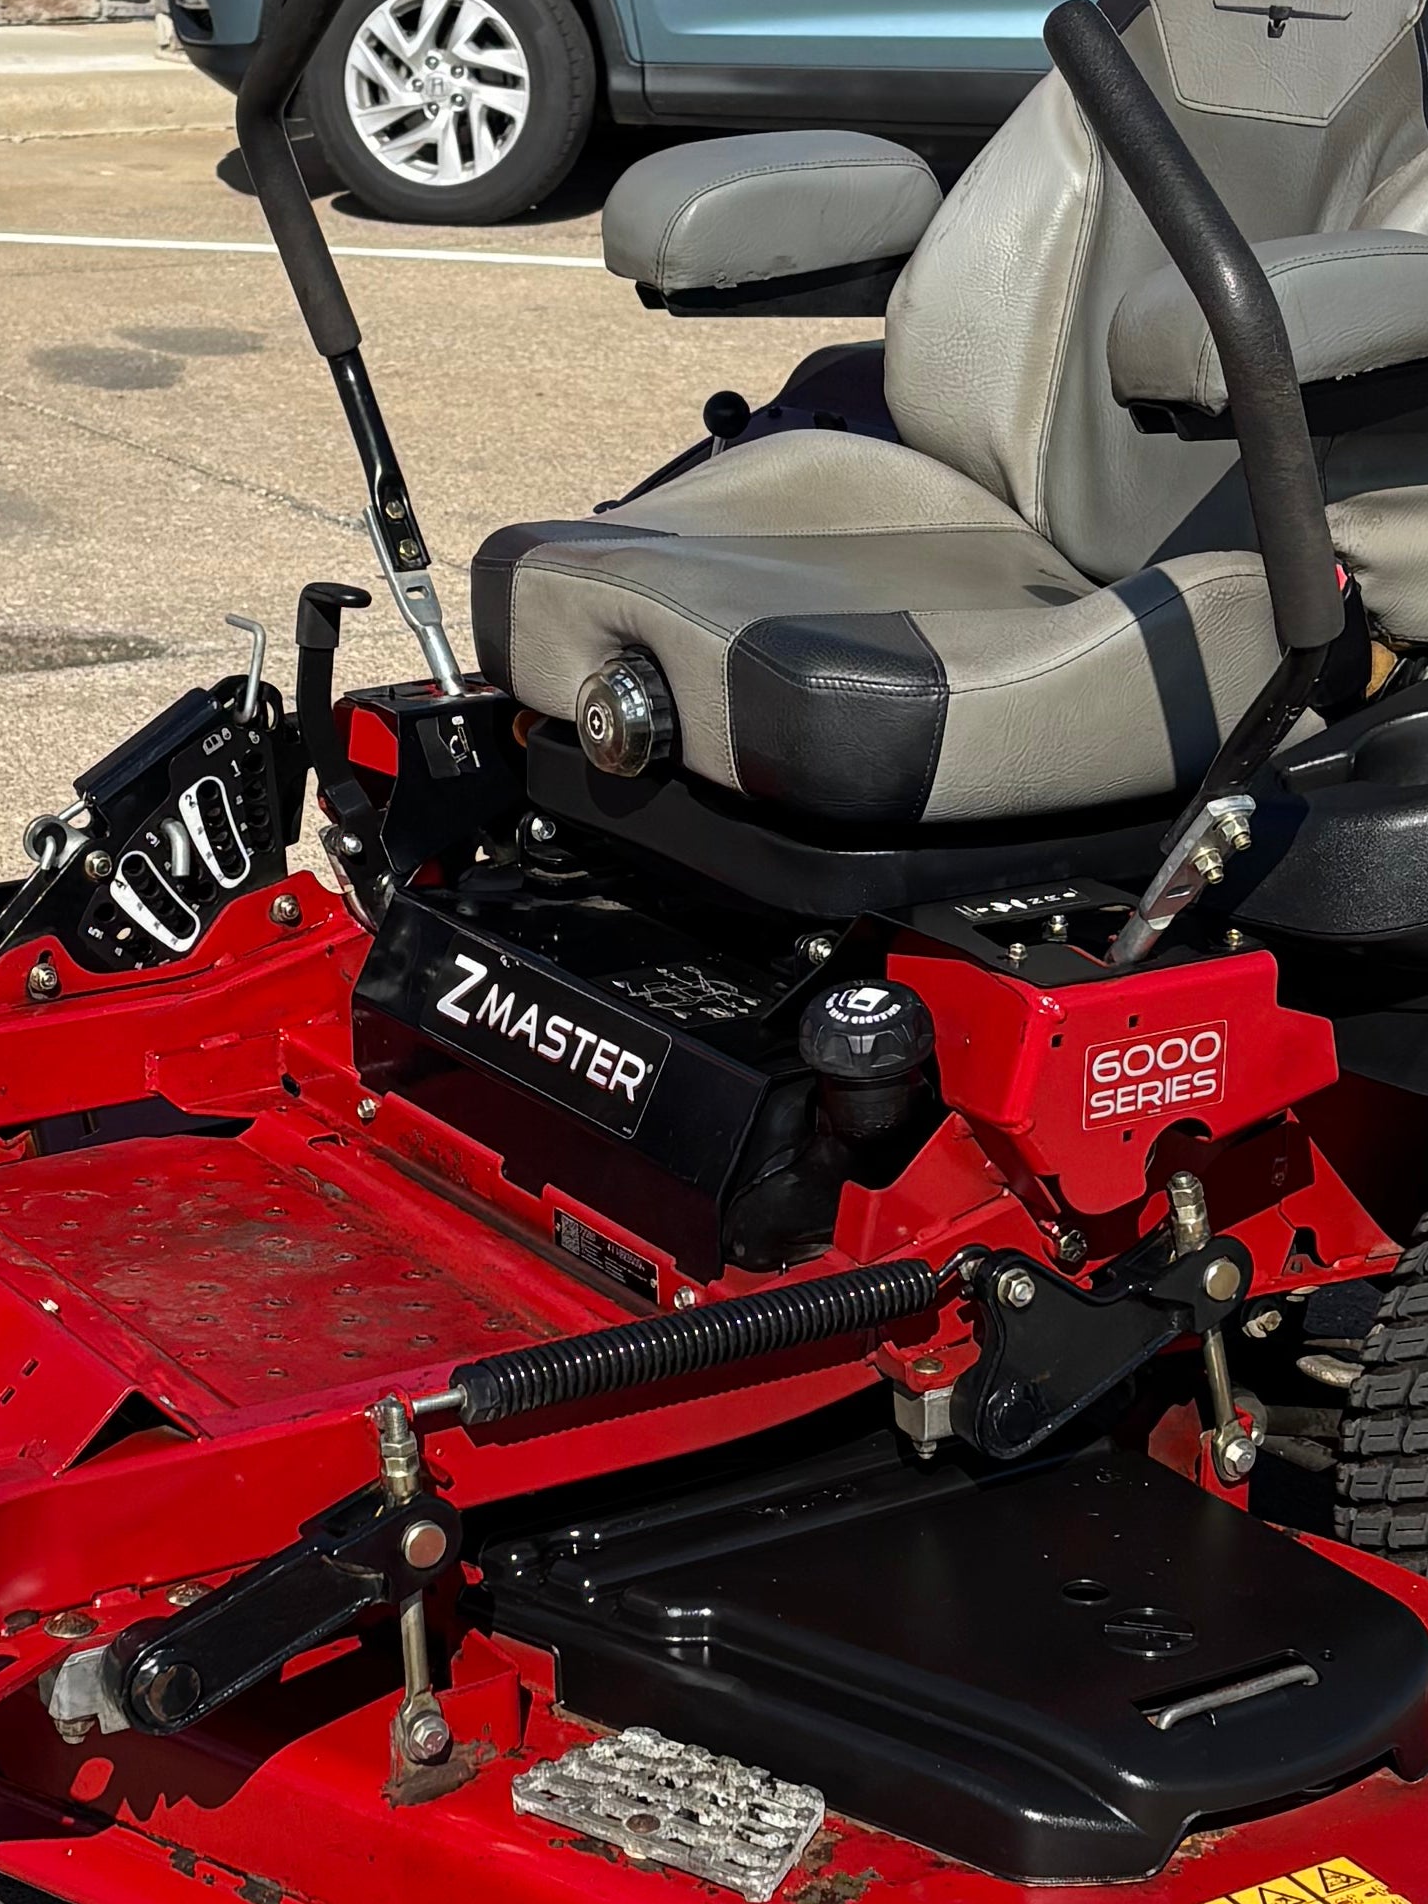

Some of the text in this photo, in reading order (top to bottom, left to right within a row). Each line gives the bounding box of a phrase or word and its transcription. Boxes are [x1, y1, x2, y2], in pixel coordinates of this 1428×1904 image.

[436, 953, 647, 1103] Z MASTER
[1091, 1030, 1222, 1084] 6000
[1089, 1068, 1218, 1120] SERIES
